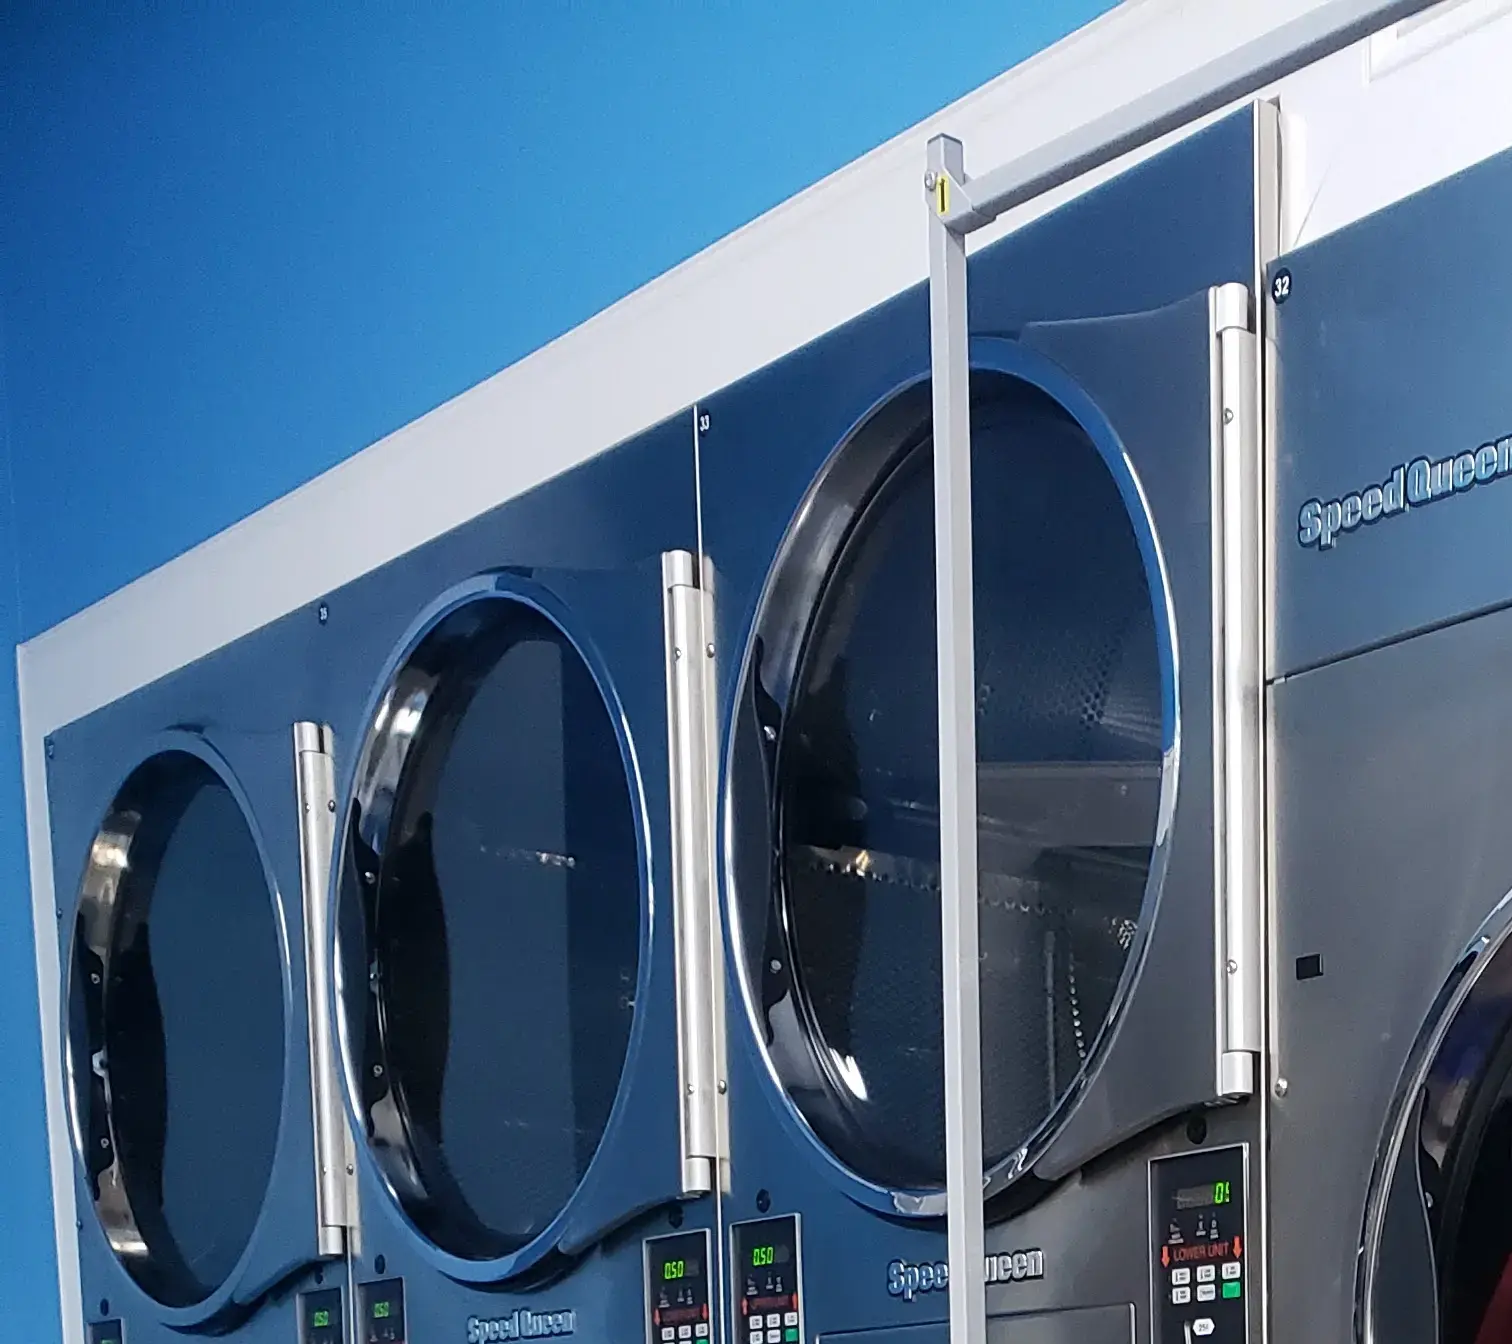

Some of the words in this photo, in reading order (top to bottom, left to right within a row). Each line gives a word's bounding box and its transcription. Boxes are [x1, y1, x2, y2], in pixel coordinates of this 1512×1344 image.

[1274, 275, 1290, 298] 32
[1298, 464, 1406, 550] Speed
[1173, 1244, 1206, 1261] LOWER
[1207, 1241, 1229, 1257] UNIT
[887, 1259, 948, 1301] Spee
[985, 1248, 1044, 1283] ueen
[519, 1308, 576, 1338] Queen
